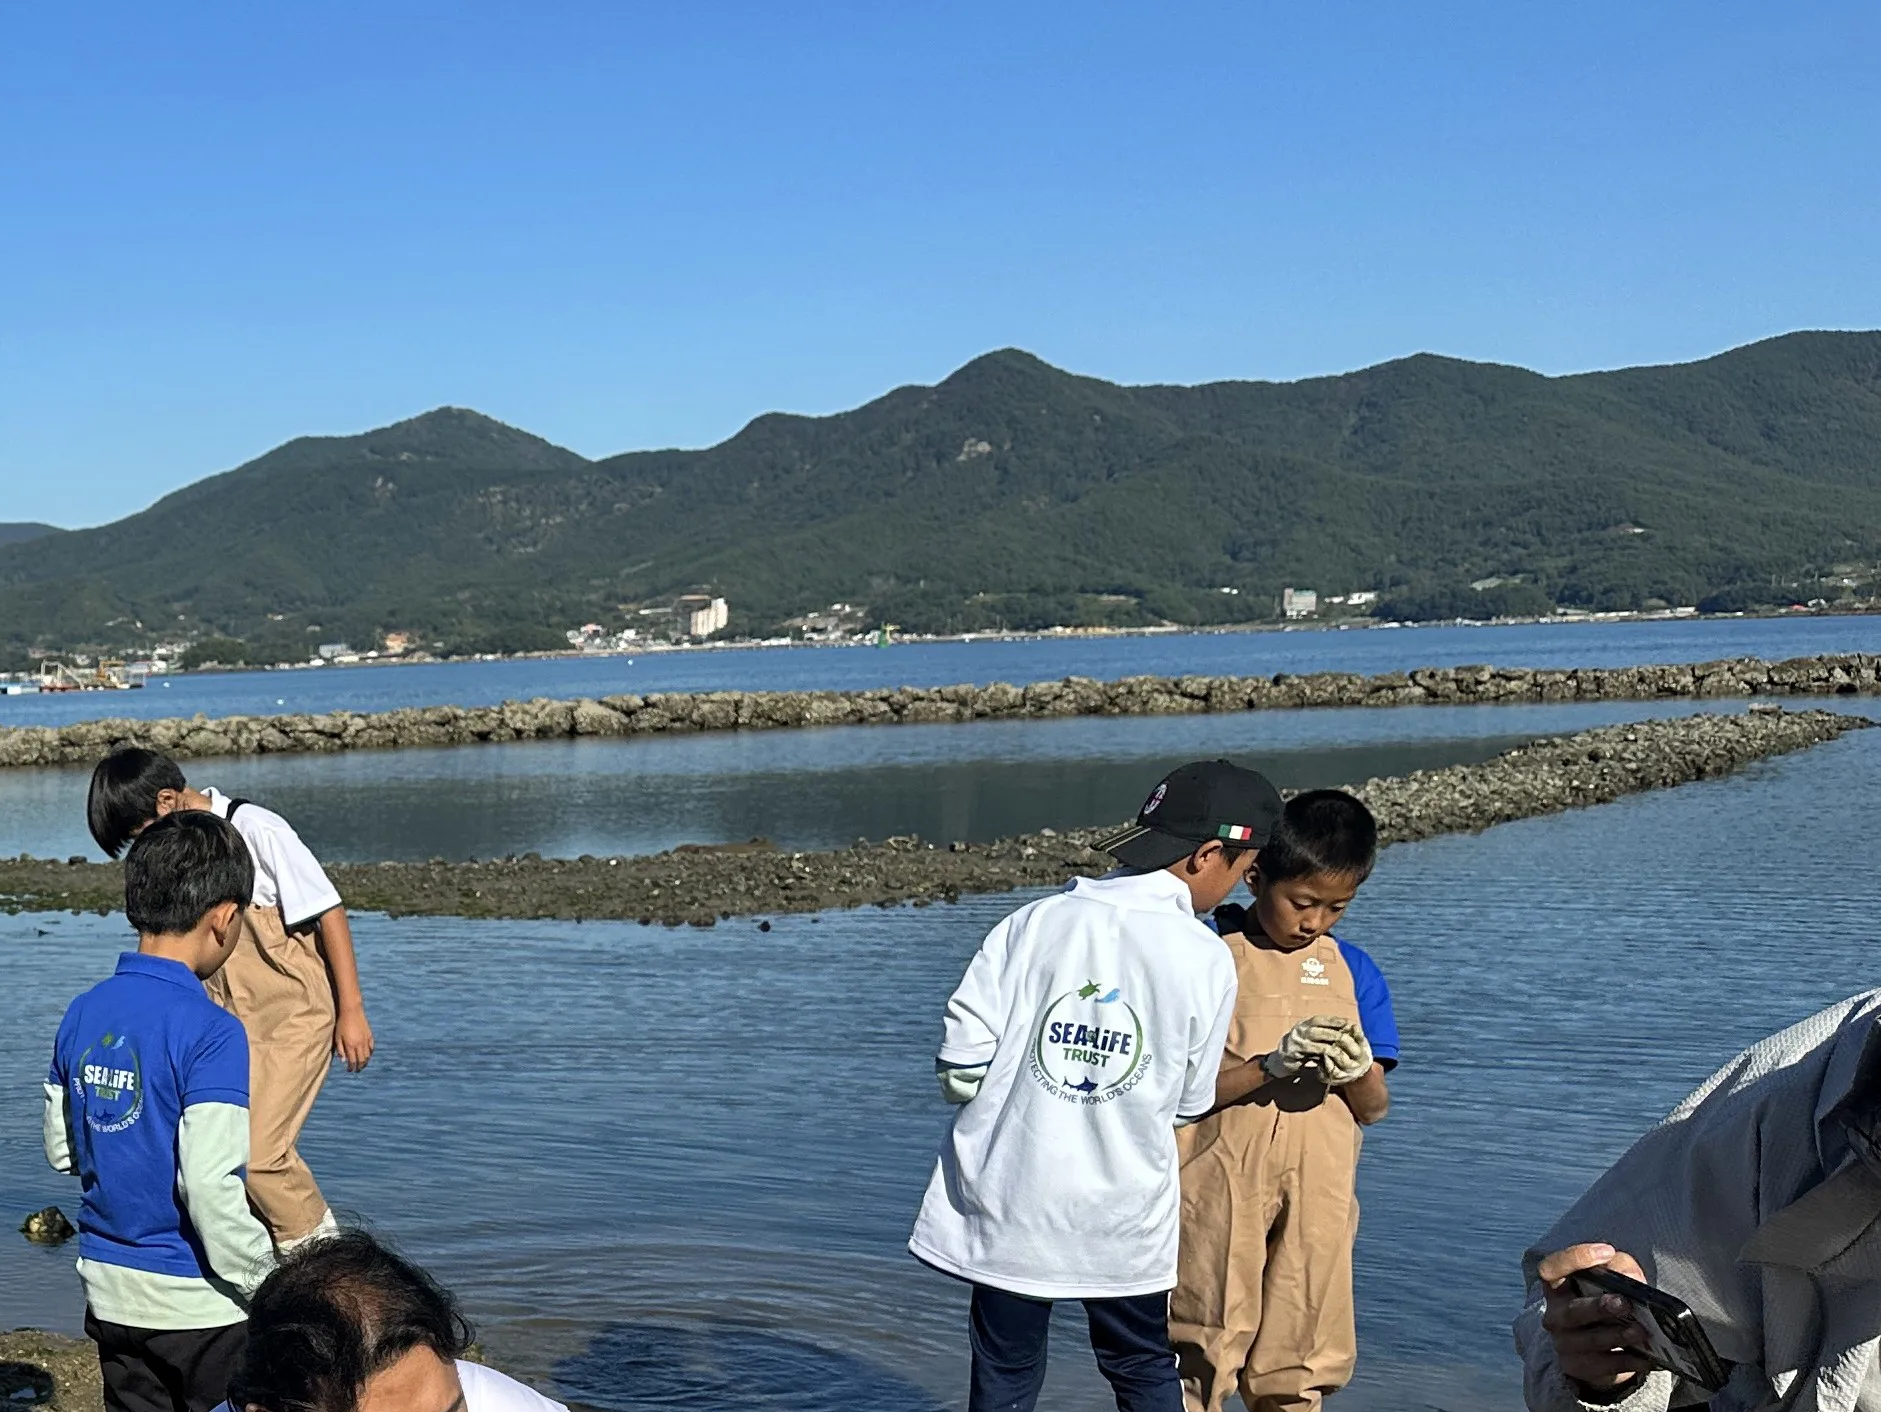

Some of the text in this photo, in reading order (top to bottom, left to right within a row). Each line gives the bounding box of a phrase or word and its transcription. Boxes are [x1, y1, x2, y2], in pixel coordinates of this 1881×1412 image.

[1048, 1021, 1089, 1046] SEA
[1062, 1047, 1111, 1068] TRUST
[1058, 1089, 1079, 1104] THE
[1081, 1088, 1125, 1106] WORLD'S
[1122, 1053, 1153, 1093] OCEANS
